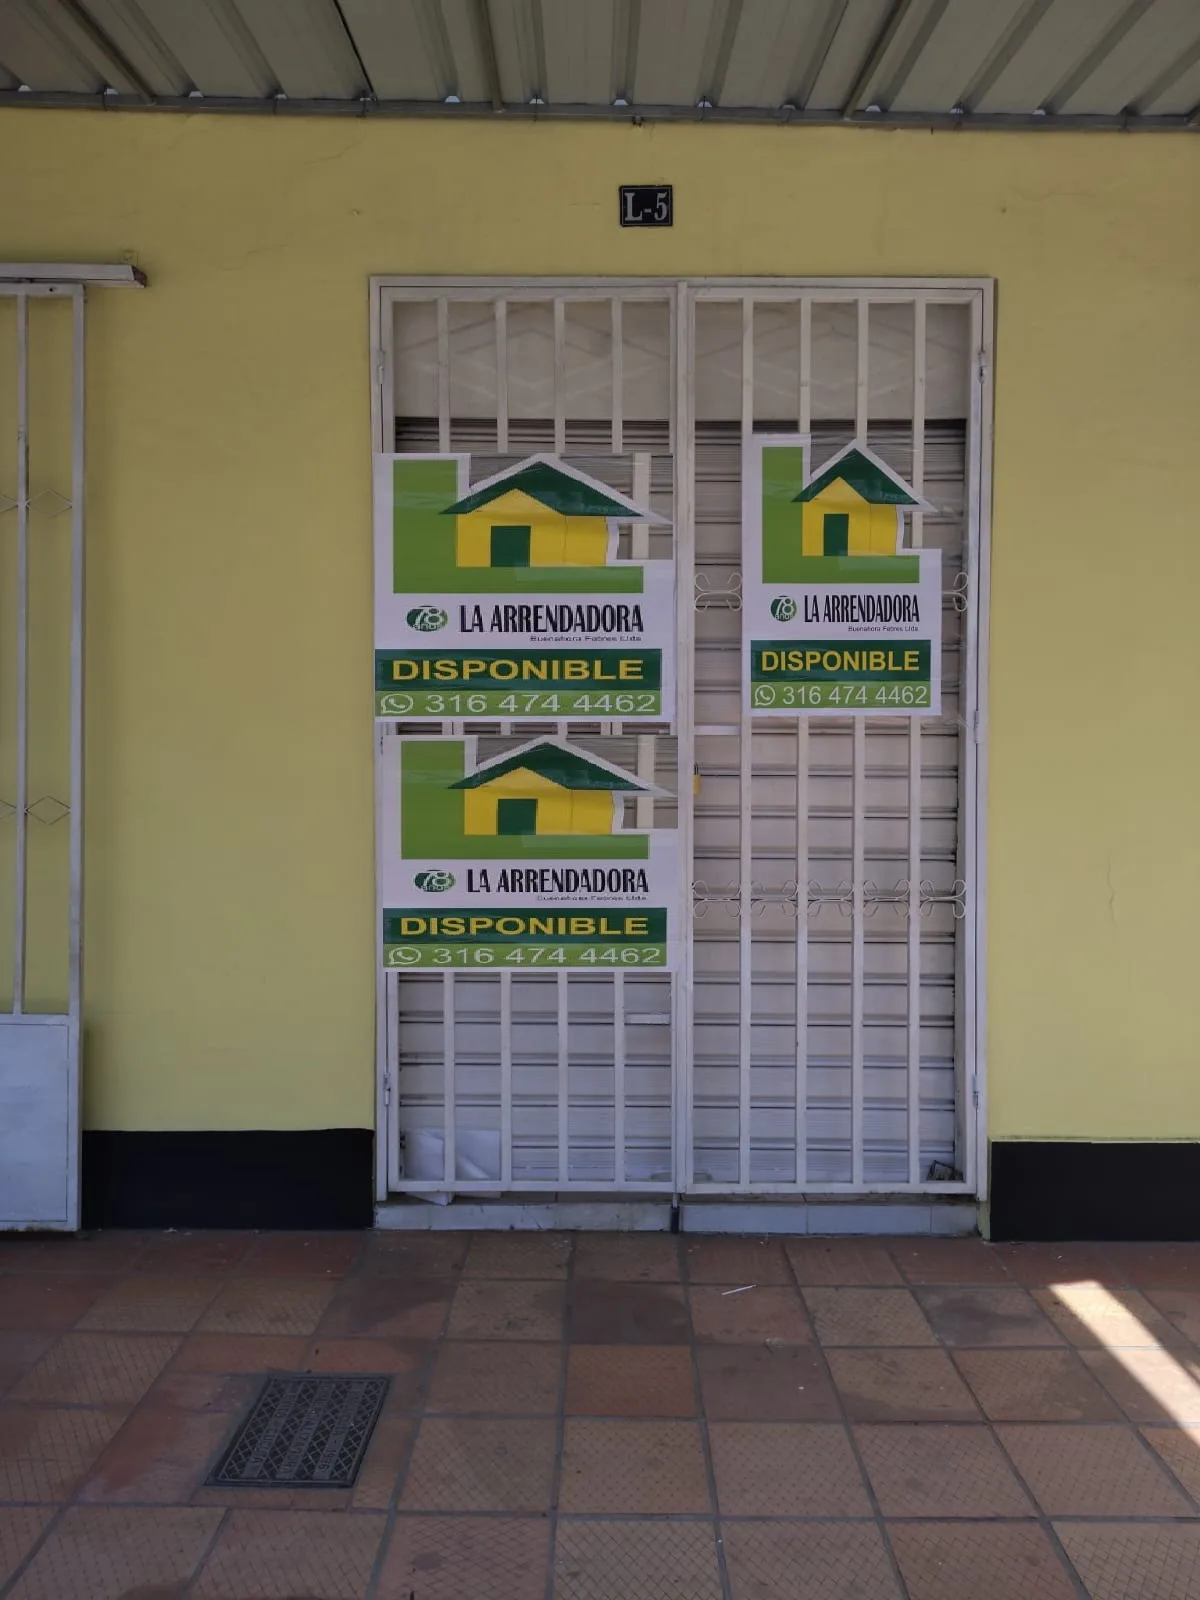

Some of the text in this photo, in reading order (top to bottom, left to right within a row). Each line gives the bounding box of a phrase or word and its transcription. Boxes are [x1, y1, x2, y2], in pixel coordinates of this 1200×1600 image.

[624, 192, 667, 221] L-5
[460, 604, 644, 633] LA ARRENDADORA
[804, 594, 920, 623] LA ARRENDADORA
[393, 659, 644, 680] DISPONIBLE
[761, 650, 920, 671] DISPONIBLE
[427, 694, 656, 713] 316 474 4462
[783, 685, 928, 704] 316 474 4462
[467, 868, 649, 893] LA ARRENDADORA
[400, 917, 649, 936] DISPONIBLE
[432, 948, 661, 964] 316 474 4462
